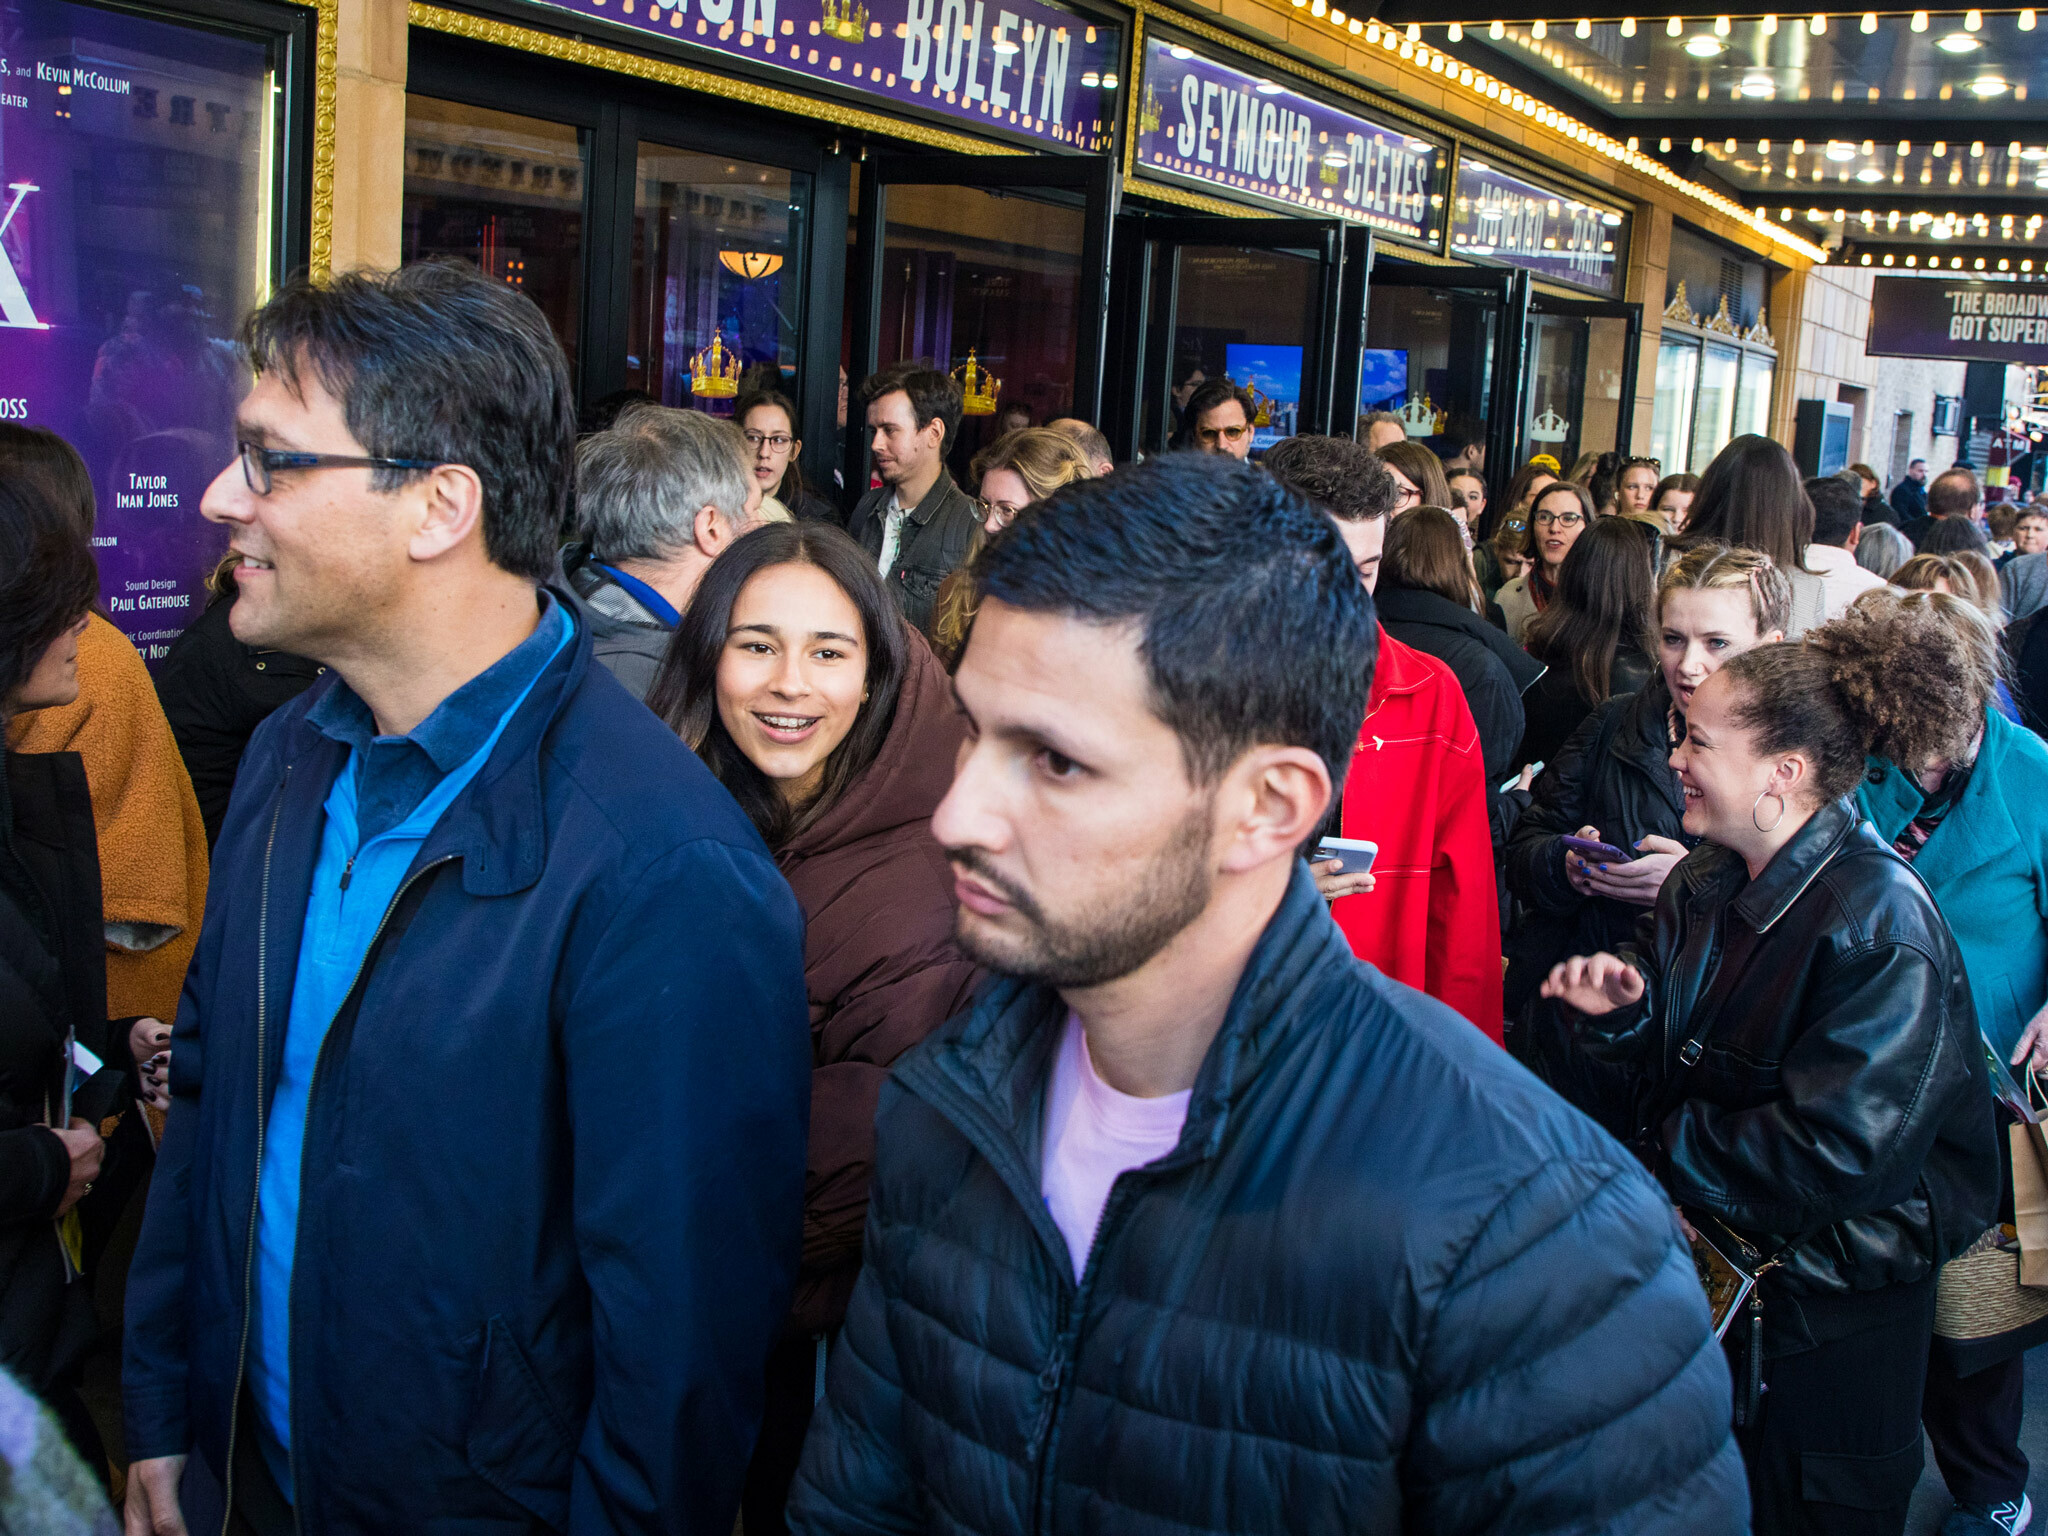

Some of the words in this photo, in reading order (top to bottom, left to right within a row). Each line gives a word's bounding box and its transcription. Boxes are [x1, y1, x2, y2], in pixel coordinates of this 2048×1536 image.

[901, 0, 1072, 125] BOLEYN
[15, 66, 32, 78] and
[37, 61, 71, 84] KEVIN
[1177, 73, 1312, 190] SEYMOUR
[1348, 134, 1429, 223] CLEVES
[1477, 181, 1545, 258] HOWARD
[1949, 314, 1988, 341] GOT
[1987, 316, 2048, 344] SUPER
[1992, 437, 2026, 451] ATM
[129, 473, 168, 489] TAYLOR
[117, 492, 144, 509] IMAN
[147, 491, 179, 508] JONES
[125, 580, 149, 592] Sound
[151, 579, 177, 590] Design
[111, 596, 136, 613] PAUL
[138, 594, 190, 611] GATEHOUSE
[138, 628, 185, 641] Coordinatio
